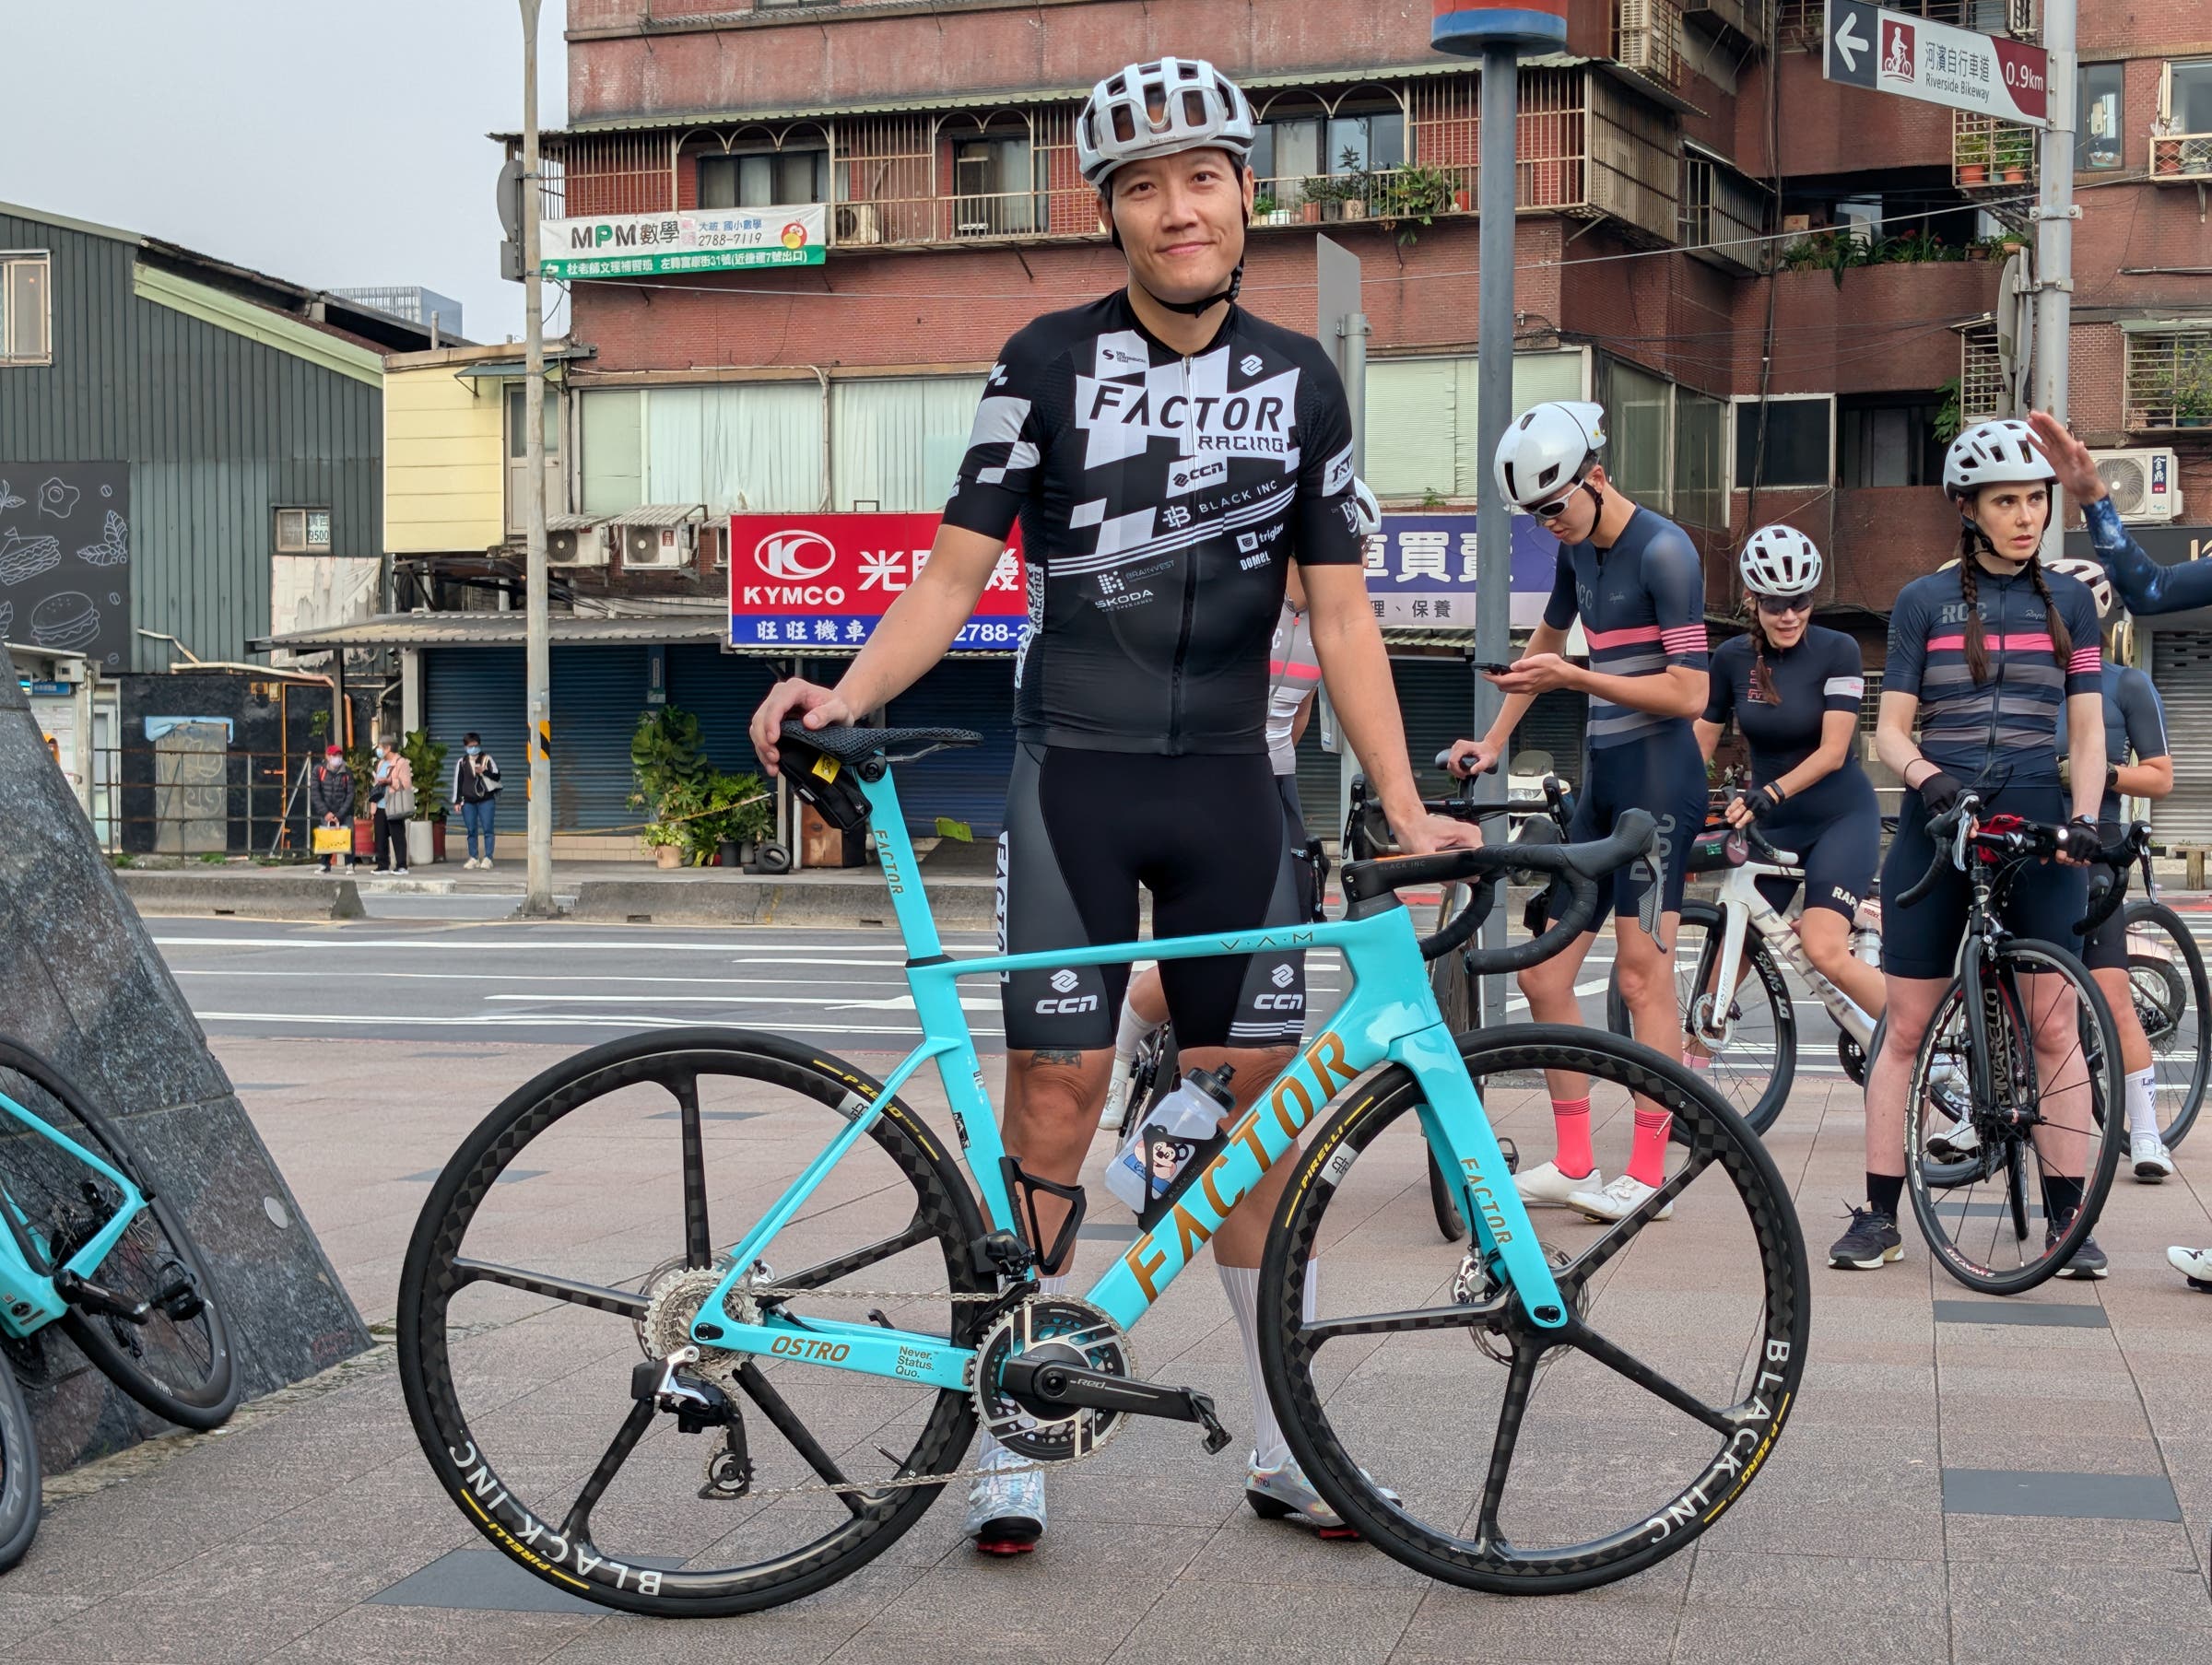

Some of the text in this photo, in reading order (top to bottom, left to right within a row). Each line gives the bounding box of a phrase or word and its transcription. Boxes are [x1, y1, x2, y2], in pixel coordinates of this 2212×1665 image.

[1924, 41, 1989, 83] 河濱自行車道
[2006, 62, 2043, 91] 0.9km
[1925, 73, 1990, 103] Riverside Bikeway
[571, 224, 637, 249] MPM
[640, 221, 680, 245] 數學
[698, 232, 762, 247] 2788-7119
[1089, 385, 1284, 433] FACTOR
[1198, 435, 1285, 453] RACING
[1199, 480, 1277, 513] BLACK INC
[1259, 522, 1284, 543] triglav
[744, 586, 845, 605] KYMCO
[2025, 609, 2047, 620] Raph
[757, 619, 866, 642] 旺旺機車
[874, 829, 904, 895] FACTOR
[996, 842, 1006, 979] FACTO
[1755, 950, 1791, 1019] DT SWISS
[1983, 988, 2011, 1107] PINARELLO
[842, 1074, 859, 1085] P
[1125, 1031, 1362, 1305] FACTOR
[1300, 1123, 1344, 1189] PIRELLI
[1461, 1157, 1513, 1246] FACTOR
[771, 1335, 851, 1363] OSTRO
[898, 1354, 935, 1370] Status.
[895, 1365, 920, 1378] Quo.
[1644, 1339, 1791, 1544] BLACK INC
[1770, 1422, 1779, 1438] P
[1740, 1436, 1772, 1484] ZERO
[449, 1440, 663, 1596] BLACK INC
[488, 1522, 552, 1571] PIRELLI
